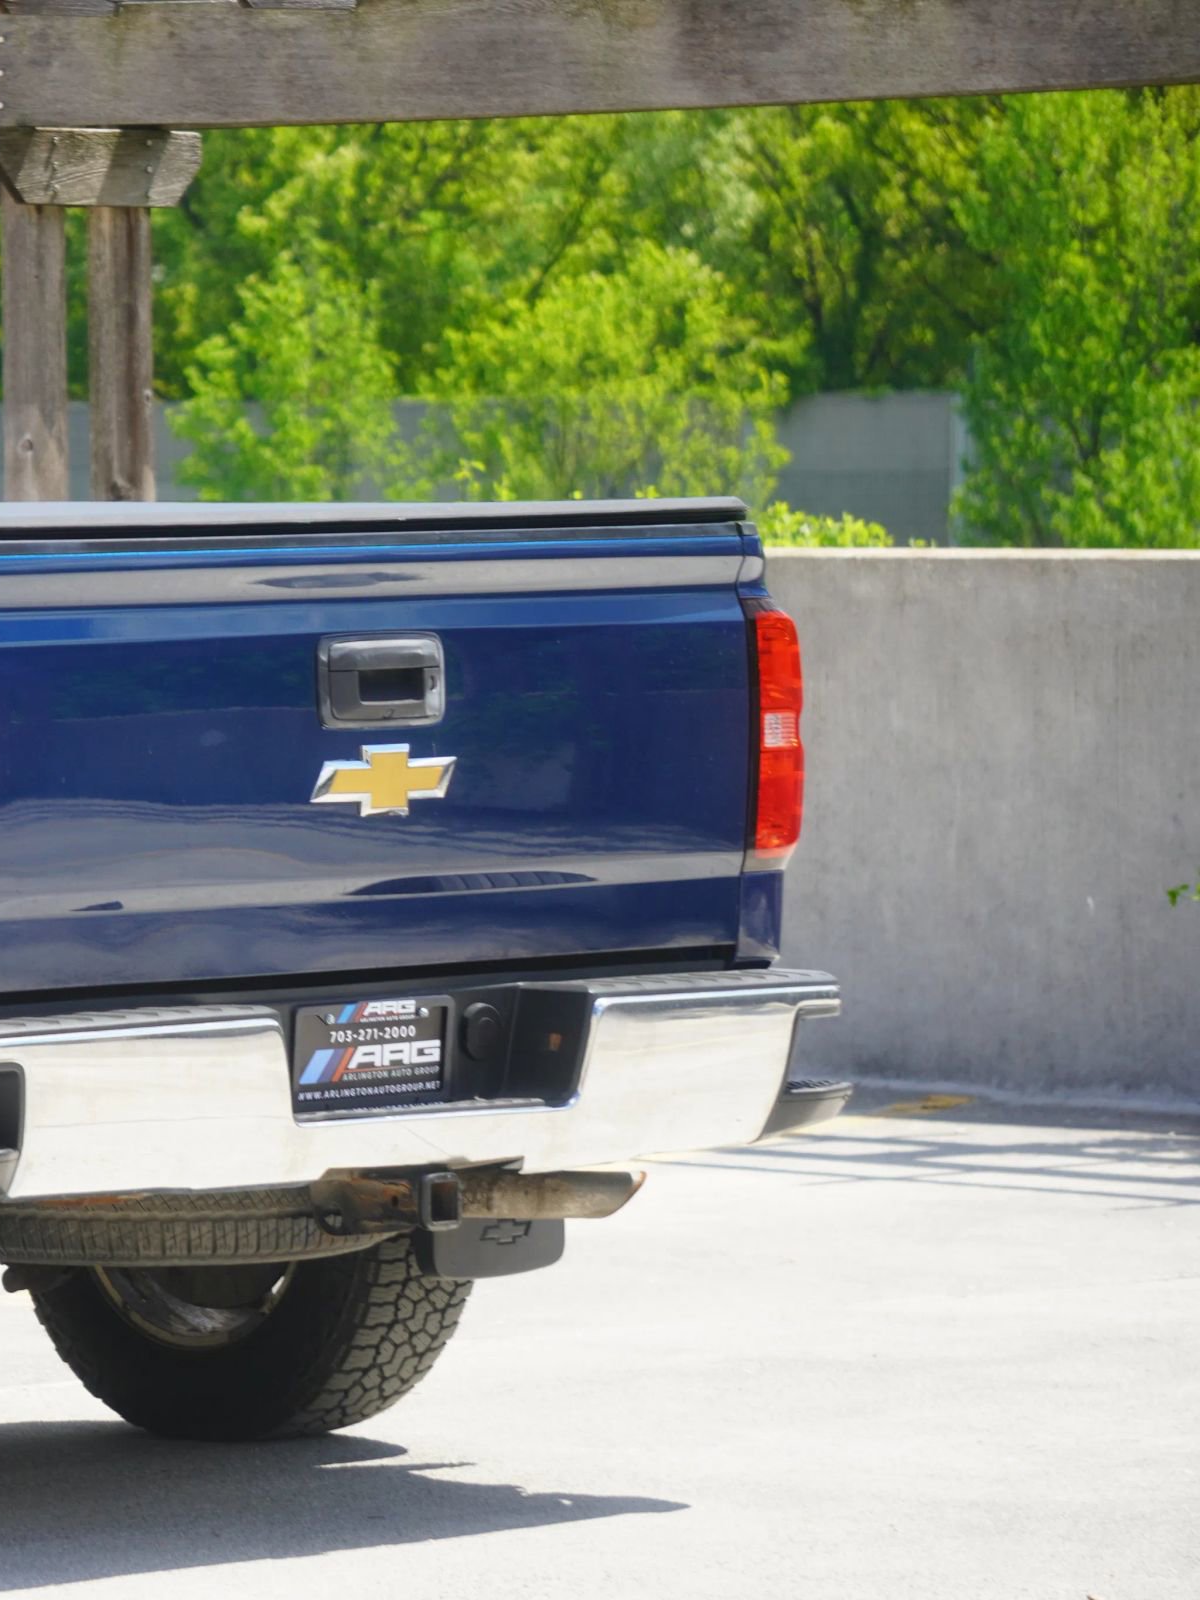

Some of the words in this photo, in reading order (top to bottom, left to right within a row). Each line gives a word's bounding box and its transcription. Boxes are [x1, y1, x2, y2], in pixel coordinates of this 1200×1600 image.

[330, 1025, 416, 1043] 703-271-2000
[342, 1070, 390, 1082] ARLINGTON
[390, 1067, 413, 1078] AUTO
[413, 1065, 440, 1076] GROUP
[298, 1081, 440, 1100] WWW.ARLINGTONAUTOGROUP.NET
